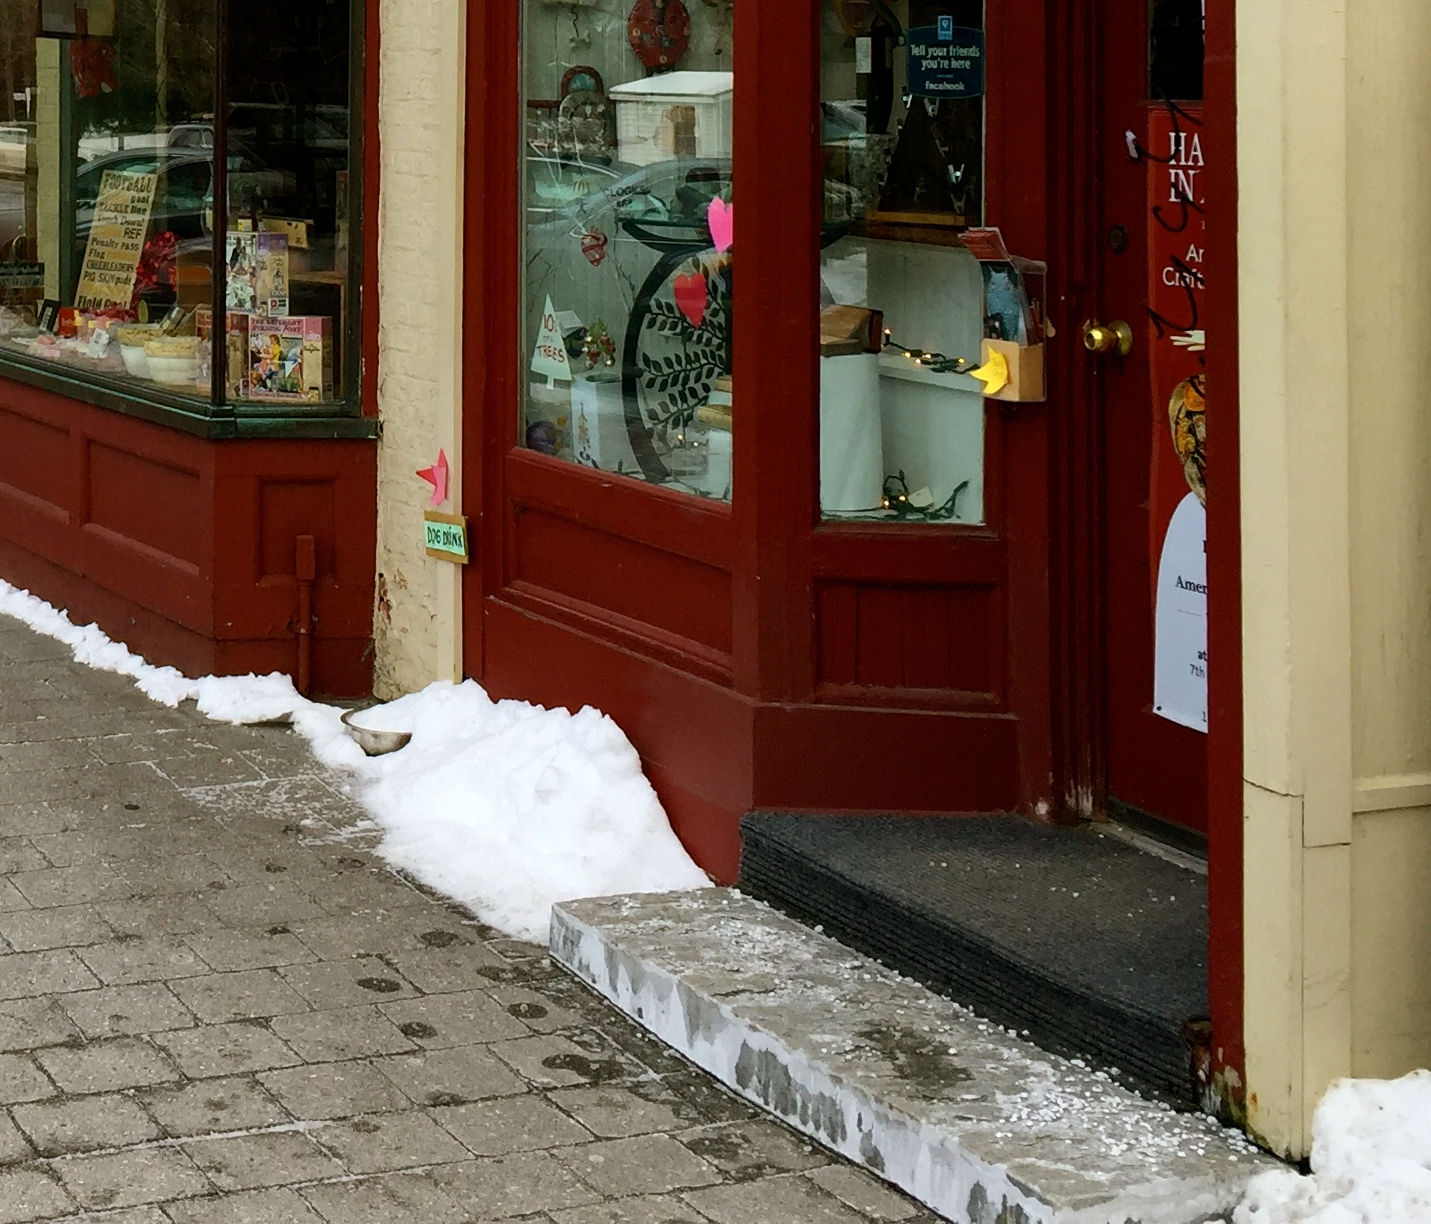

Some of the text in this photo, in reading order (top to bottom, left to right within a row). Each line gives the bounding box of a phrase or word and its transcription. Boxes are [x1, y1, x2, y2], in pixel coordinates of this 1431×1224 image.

[910, 44, 980, 58] Tell your friends
[921, 58, 971, 71] you're here
[925, 80, 965, 90] facebook
[123, 227, 143, 239] REF
[91, 237, 139, 251] Penalty PASS
[88, 248, 105, 260] Flag
[83, 271, 96, 282] PIG
[283, 325, 301, 333] POST
[536, 345, 565, 363] TREES
[1190, 663, 1205, 678] 7th
